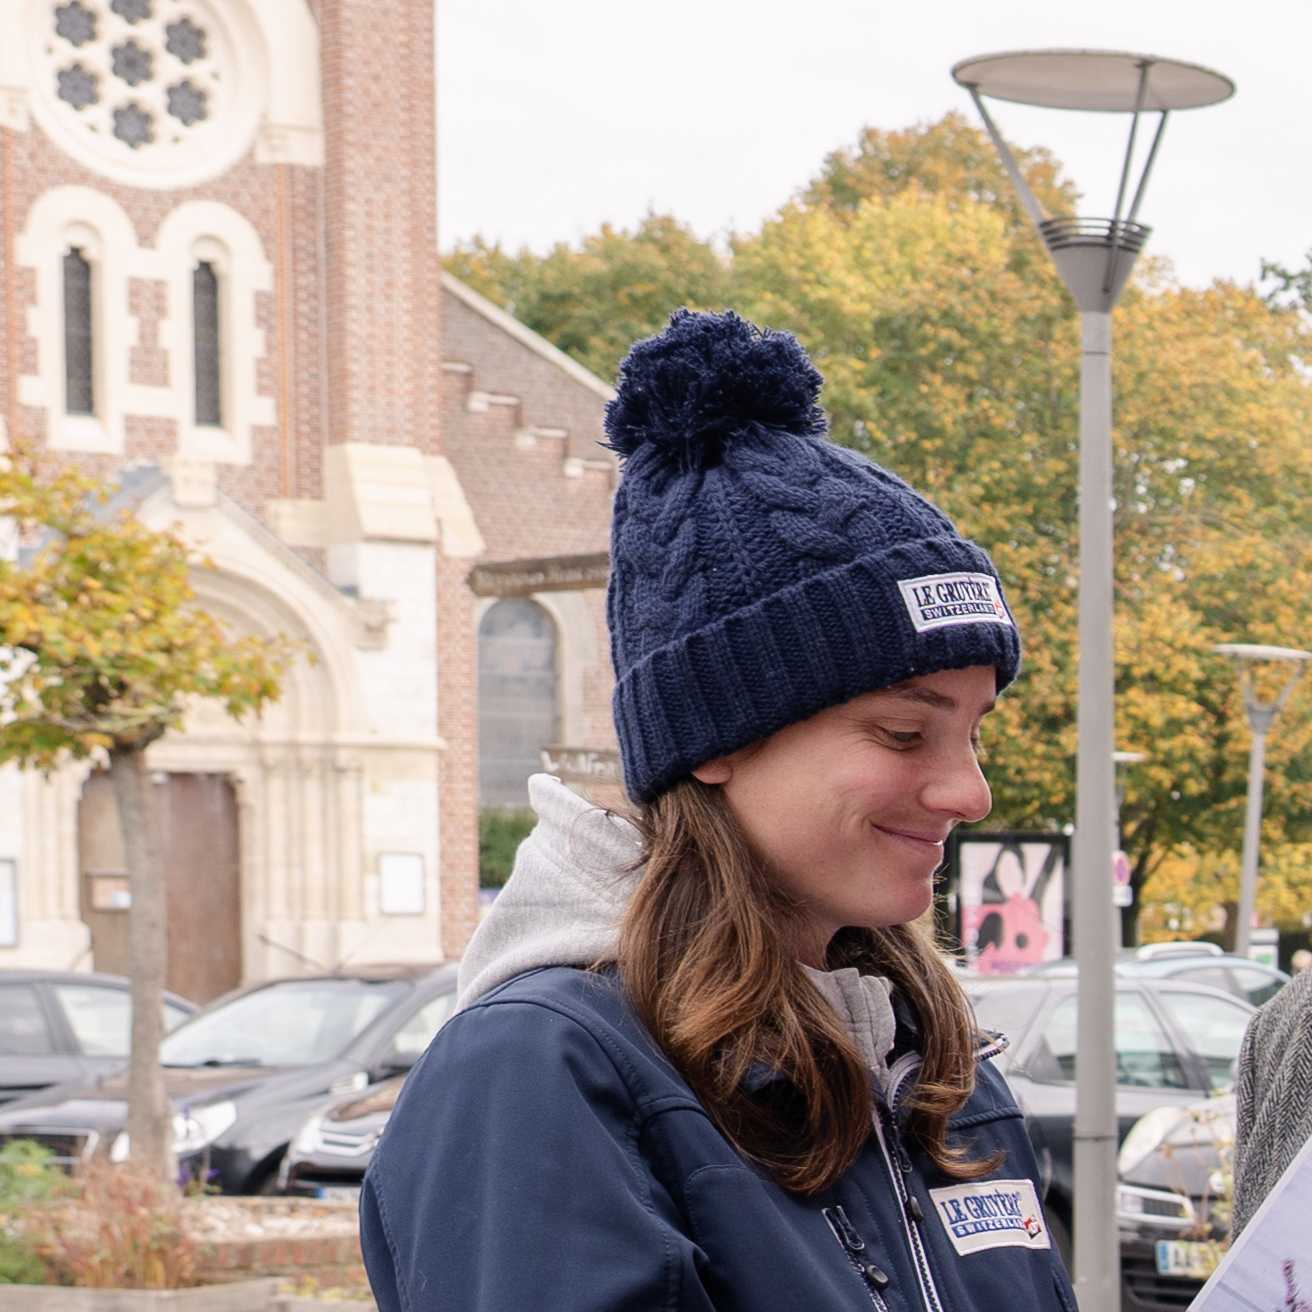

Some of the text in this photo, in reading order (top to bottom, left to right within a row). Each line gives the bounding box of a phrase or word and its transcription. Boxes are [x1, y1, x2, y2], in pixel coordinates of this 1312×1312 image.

[912, 577, 992, 607] LE GRUYÈRE
[940, 1189, 1022, 1224] LE GRUYÈRE
